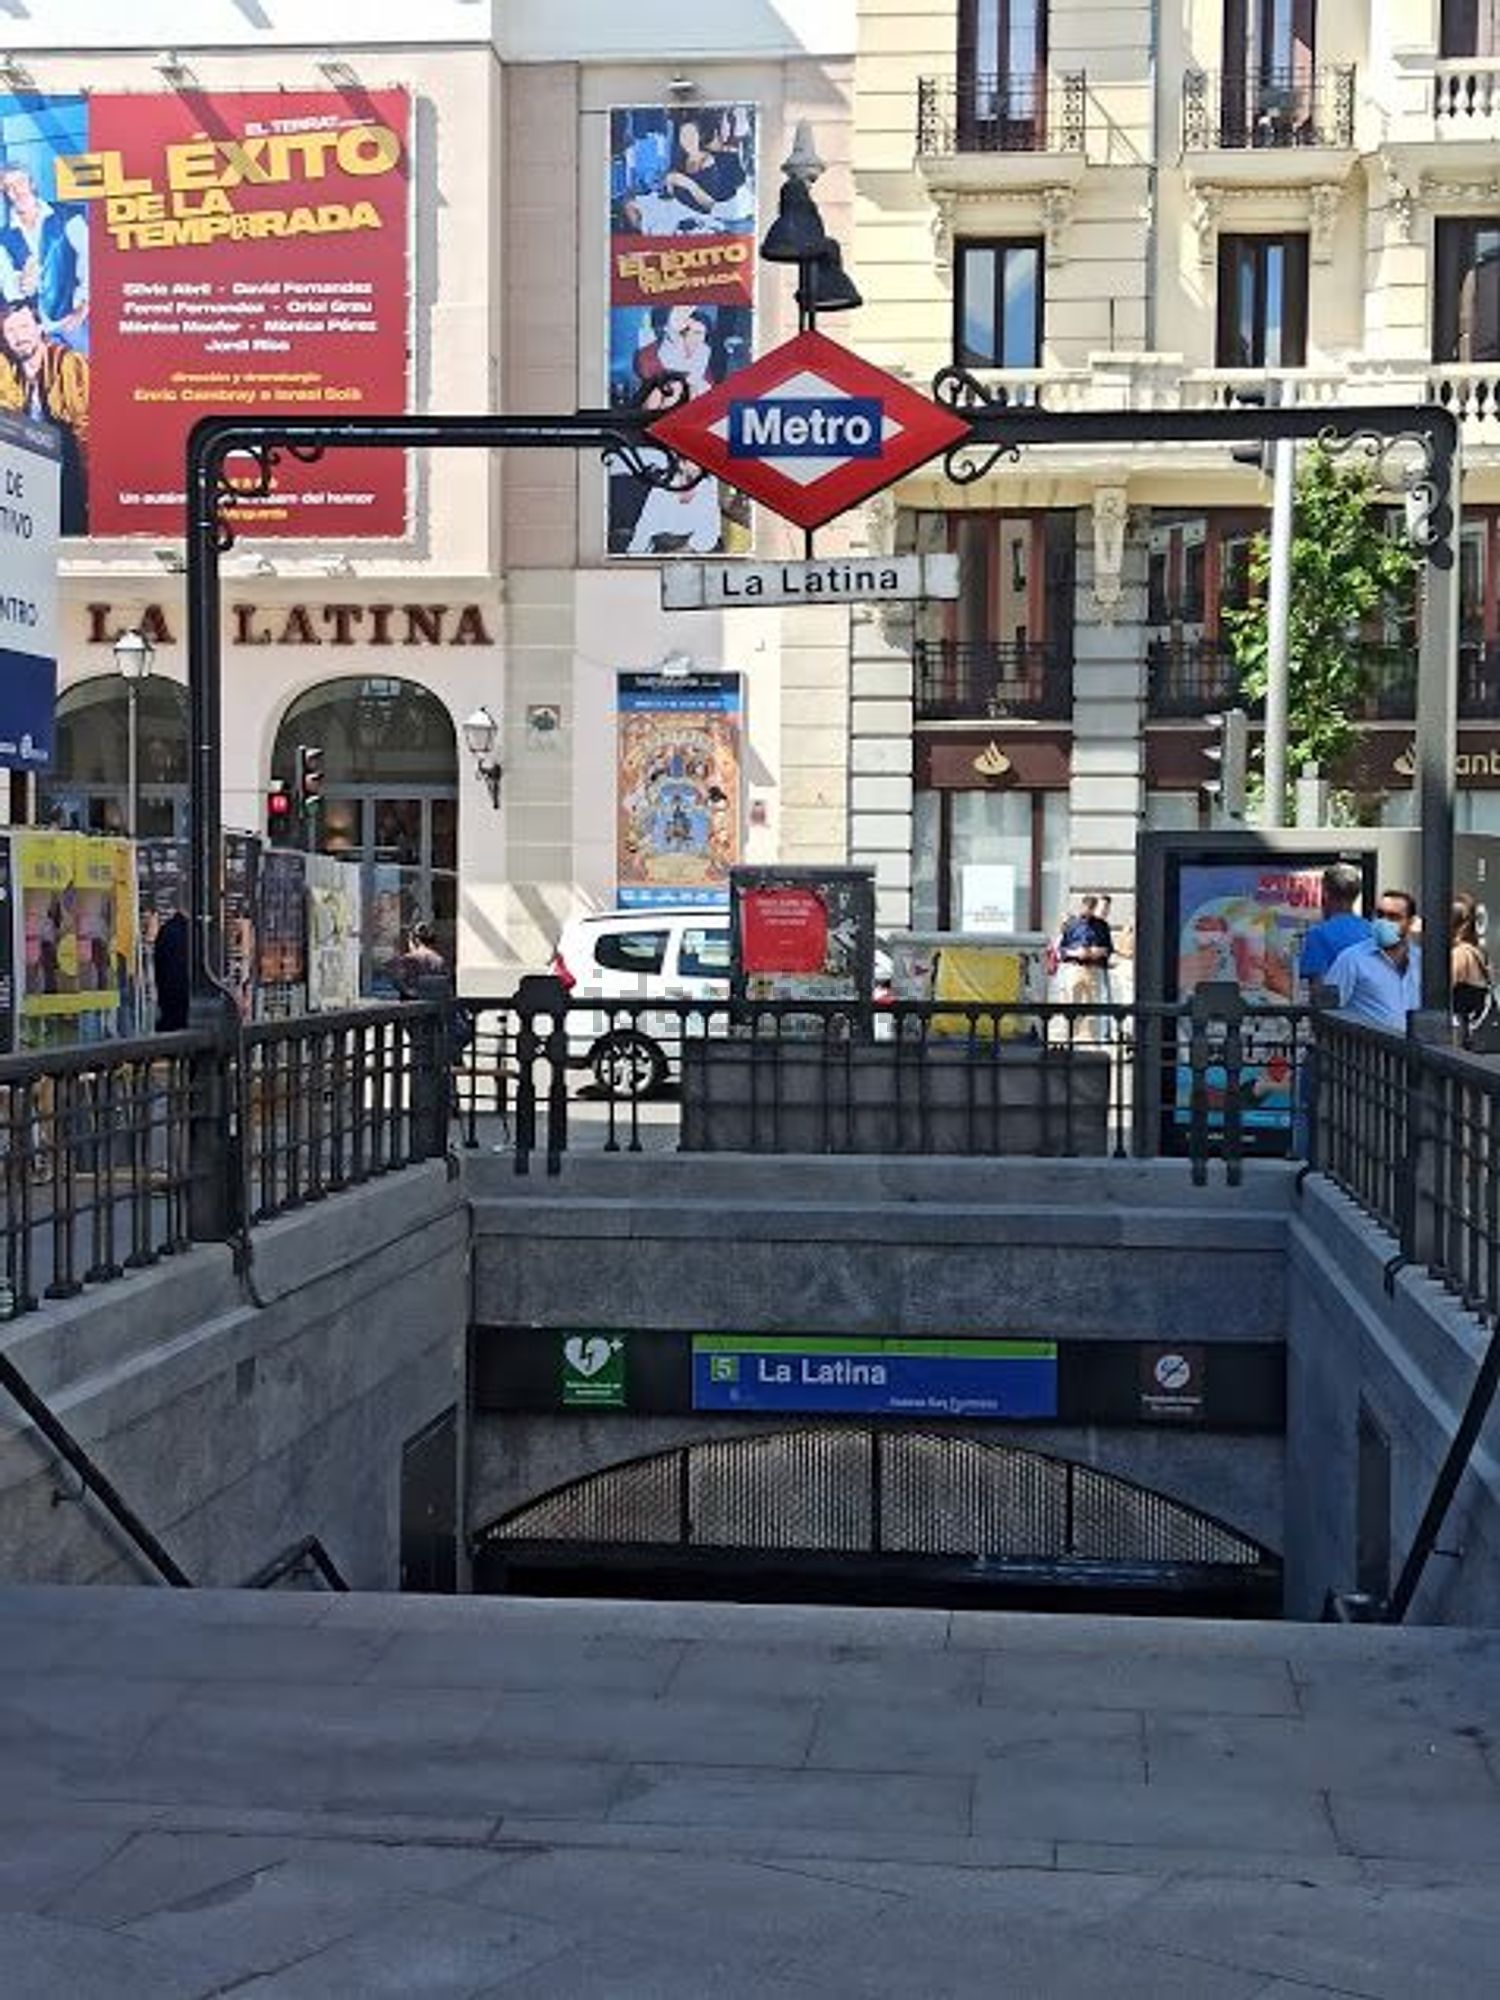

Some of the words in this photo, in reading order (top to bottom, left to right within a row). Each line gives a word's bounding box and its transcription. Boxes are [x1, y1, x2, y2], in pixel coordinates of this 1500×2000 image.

[55, 150, 152, 201] EL
[165, 124, 401, 191] ÉXITO
[107, 194, 164, 225] DE
[172, 188, 234, 218] LA
[741, 408, 872, 446] Metro
[722, 571, 763, 596] La
[782, 565, 899, 594] Latina
[86, 602, 176, 643] LA
[233, 603, 495, 645] LATINA
[716, 1357, 733, 1381] 5
[759, 1357, 791, 1383] La
[801, 1358, 887, 1386] Latina
